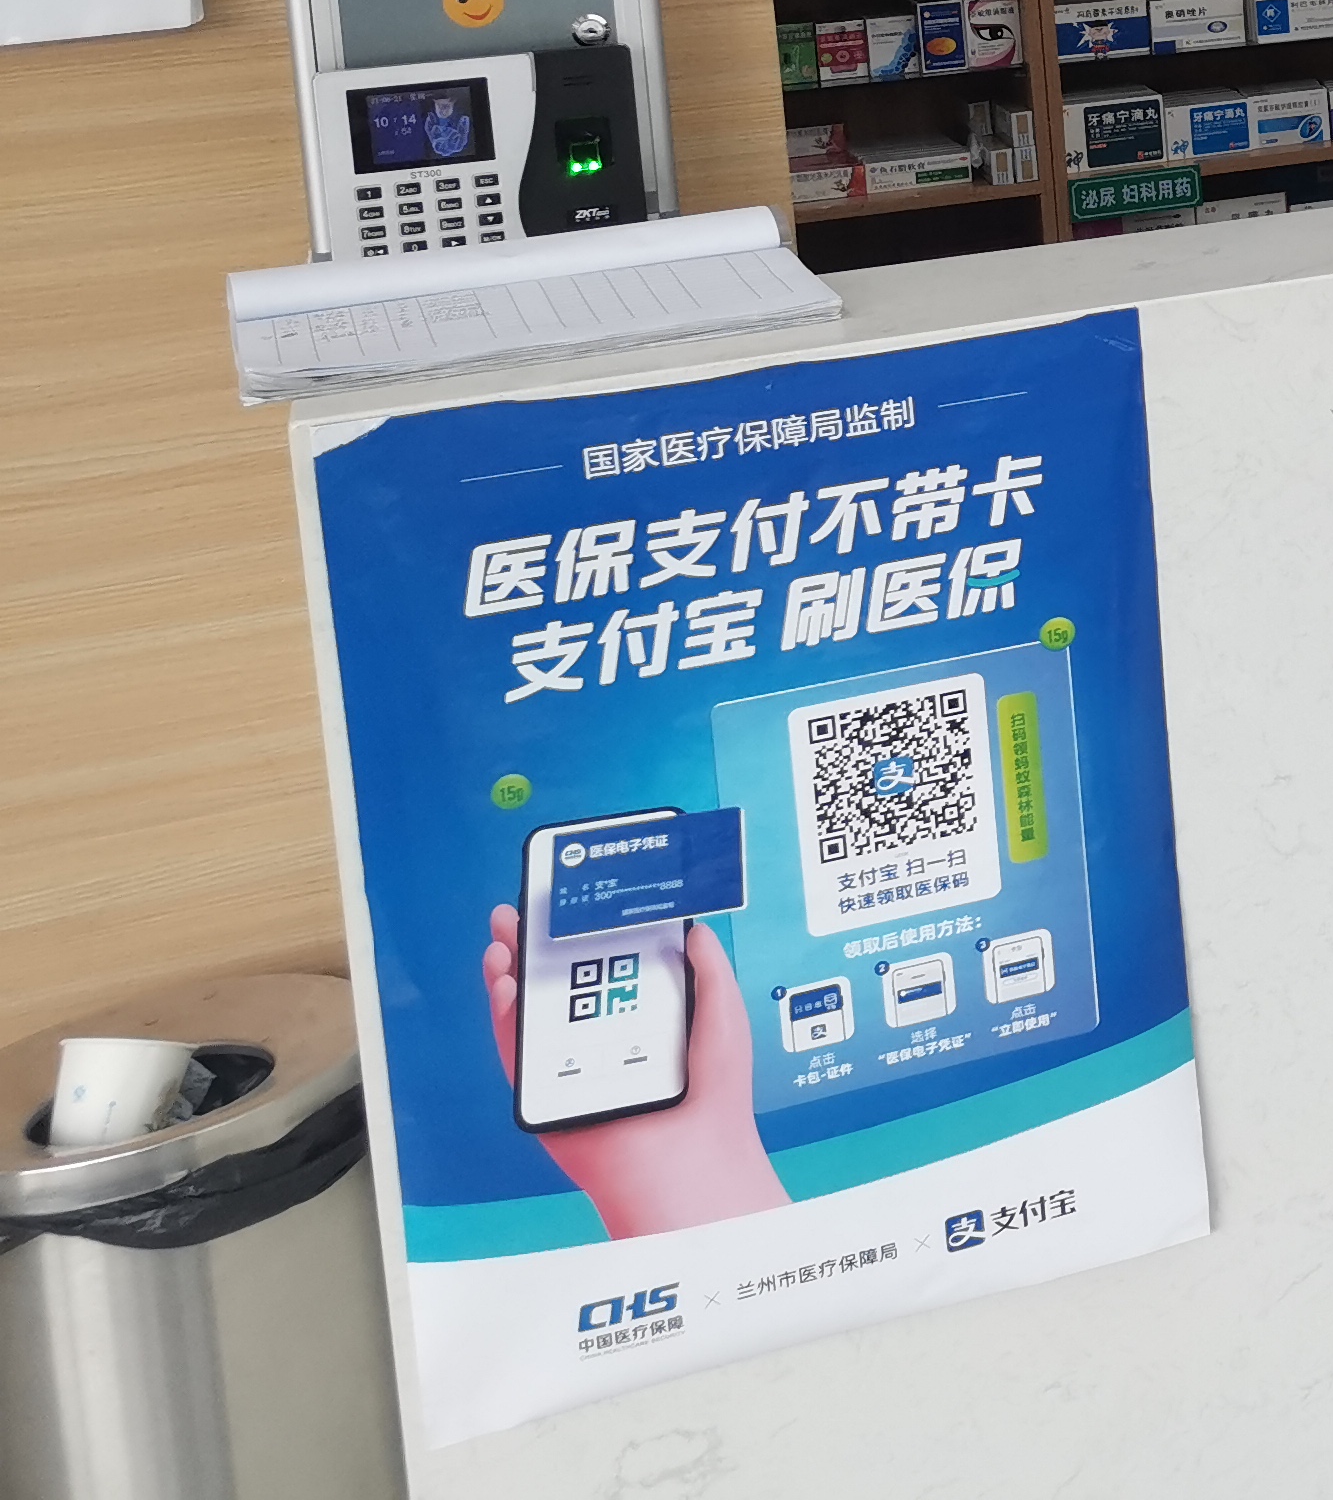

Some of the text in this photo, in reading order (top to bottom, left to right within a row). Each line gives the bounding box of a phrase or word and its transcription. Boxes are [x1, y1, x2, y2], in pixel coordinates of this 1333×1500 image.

[1087, 106, 1160, 127] 牙痛宁滴丸
[1192, 106, 1248, 123] 牙痛宁滴丸
[410, 169, 443, 180] ST300
[366, 189, 372, 199] 1
[1081, 176, 1192, 210] 泌尿 妇科用药
[582, 396, 916, 481] 国家医疗保障局监制
[464, 454, 1044, 618] 医保支付不带卡
[505, 538, 1023, 703] 支付宝 刷医保
[1042, 623, 1071, 645] 15g
[499, 782, 527, 805] 15g
[1008, 711, 1038, 845] 扫码领蚂蚁森林能量
[588, 833, 670, 860] 医保电子凭证
[836, 848, 967, 893] 支付宝 扫一扫
[837, 871, 971, 915] 快速领取医保码
[842, 914, 983, 960] 领取后使用方法：
[991, 1011, 1058, 1039] “立即使用”
[1010, 1003, 1037, 1020] 点击
[878, 1032, 972, 1066] “医保电子凭证”
[910, 1026, 938, 1045] 选择
[793, 1063, 854, 1088] 卡包-证件
[808, 1052, 836, 1069] 点击
[991, 1187, 1077, 1238] 支付宝
[736, 1241, 899, 1302] 兰州市医疗保障局
[577, 1281, 681, 1334] CHS
[578, 1315, 685, 1354] 中国医疗保障
